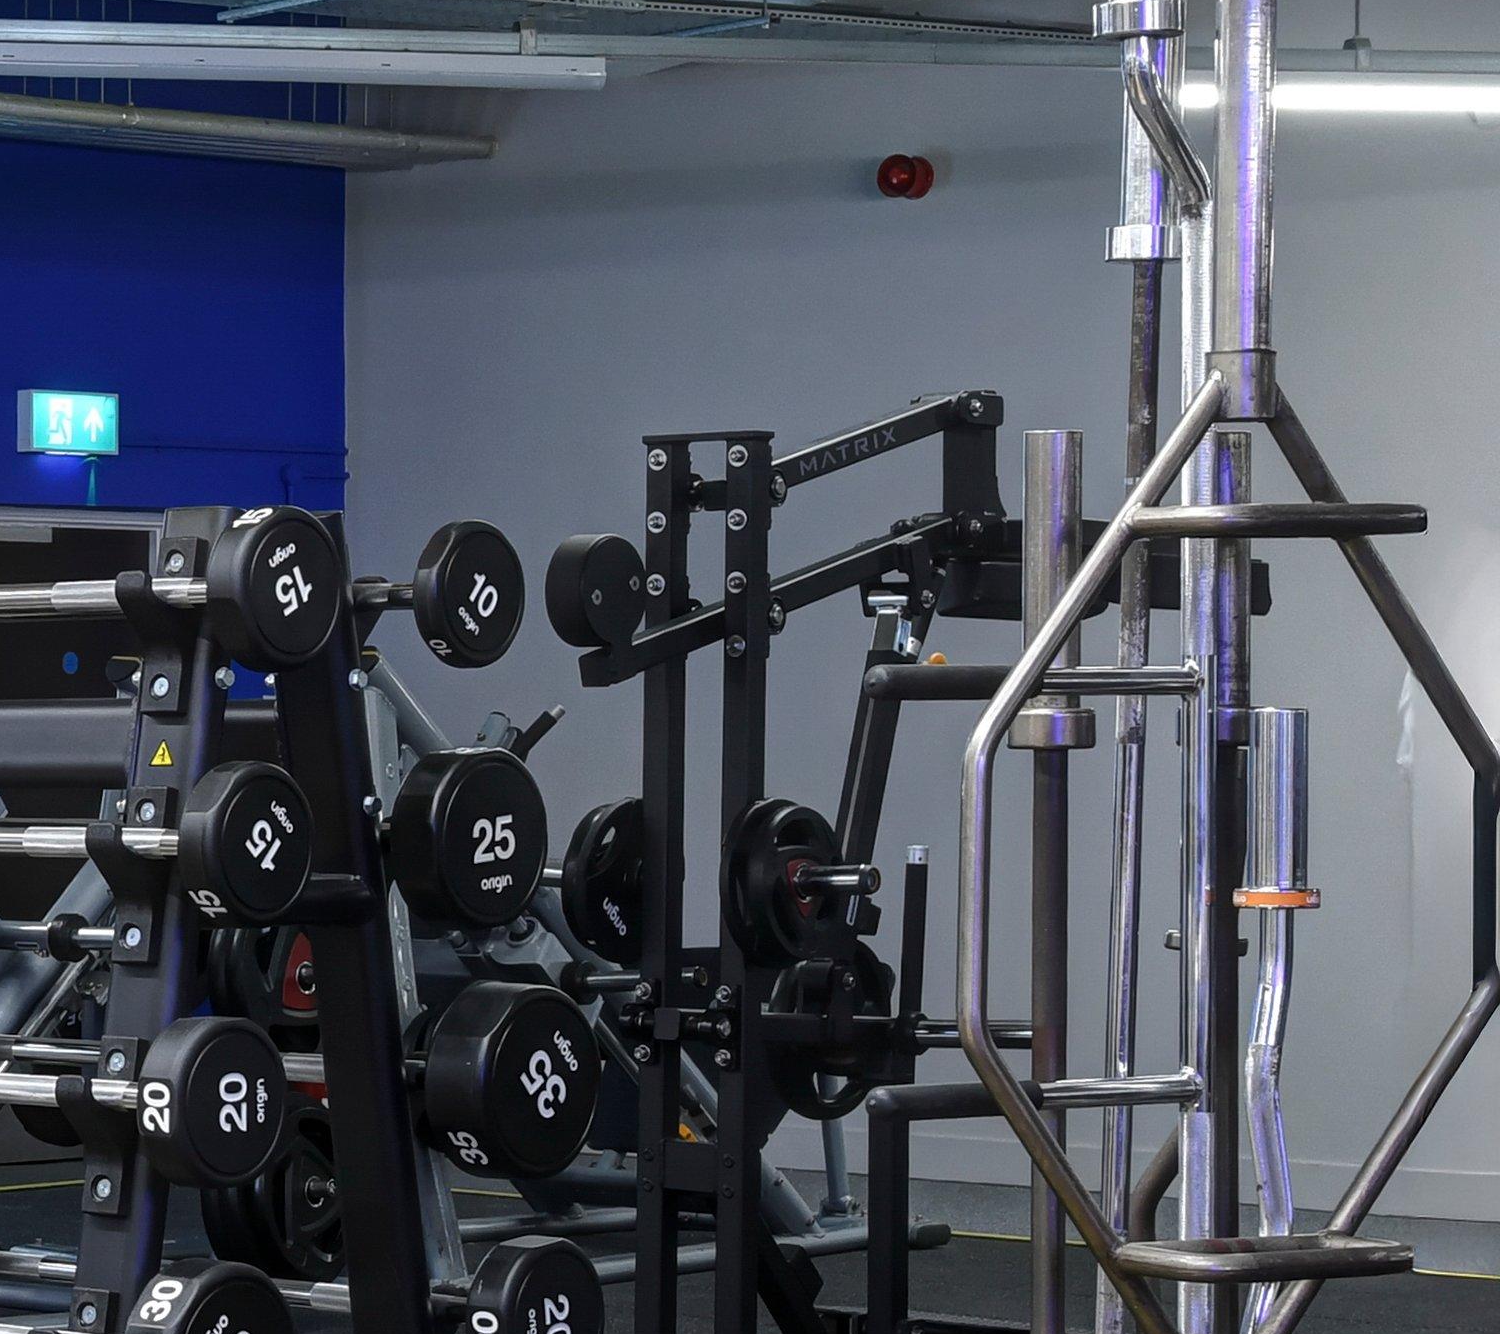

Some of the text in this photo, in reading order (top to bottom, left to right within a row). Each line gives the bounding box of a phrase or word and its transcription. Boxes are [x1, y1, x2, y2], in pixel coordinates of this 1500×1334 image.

[799, 426, 897, 477] MATRIX
[232, 508, 273, 528] 15
[268, 543, 296, 568] origin
[275, 565, 312, 617] 15
[469, 572, 498, 618] 10
[458, 607, 479, 636] origin
[429, 639, 452, 656] 10
[270, 799, 296, 835] origin
[244, 817, 283, 872] 15
[472, 814, 516, 865] 25
[188, 887, 228, 920] 15
[481, 874, 513, 893] origin
[601, 896, 628, 937] origin
[552, 1029, 579, 1073] origin
[218, 1071, 249, 1134] 20
[254, 1077, 267, 1124] origin
[518, 1049, 568, 1120] 35
[142, 1080, 171, 1134] 20
[443, 1129, 490, 1166] 35
[138, 1278, 184, 1323] 30
